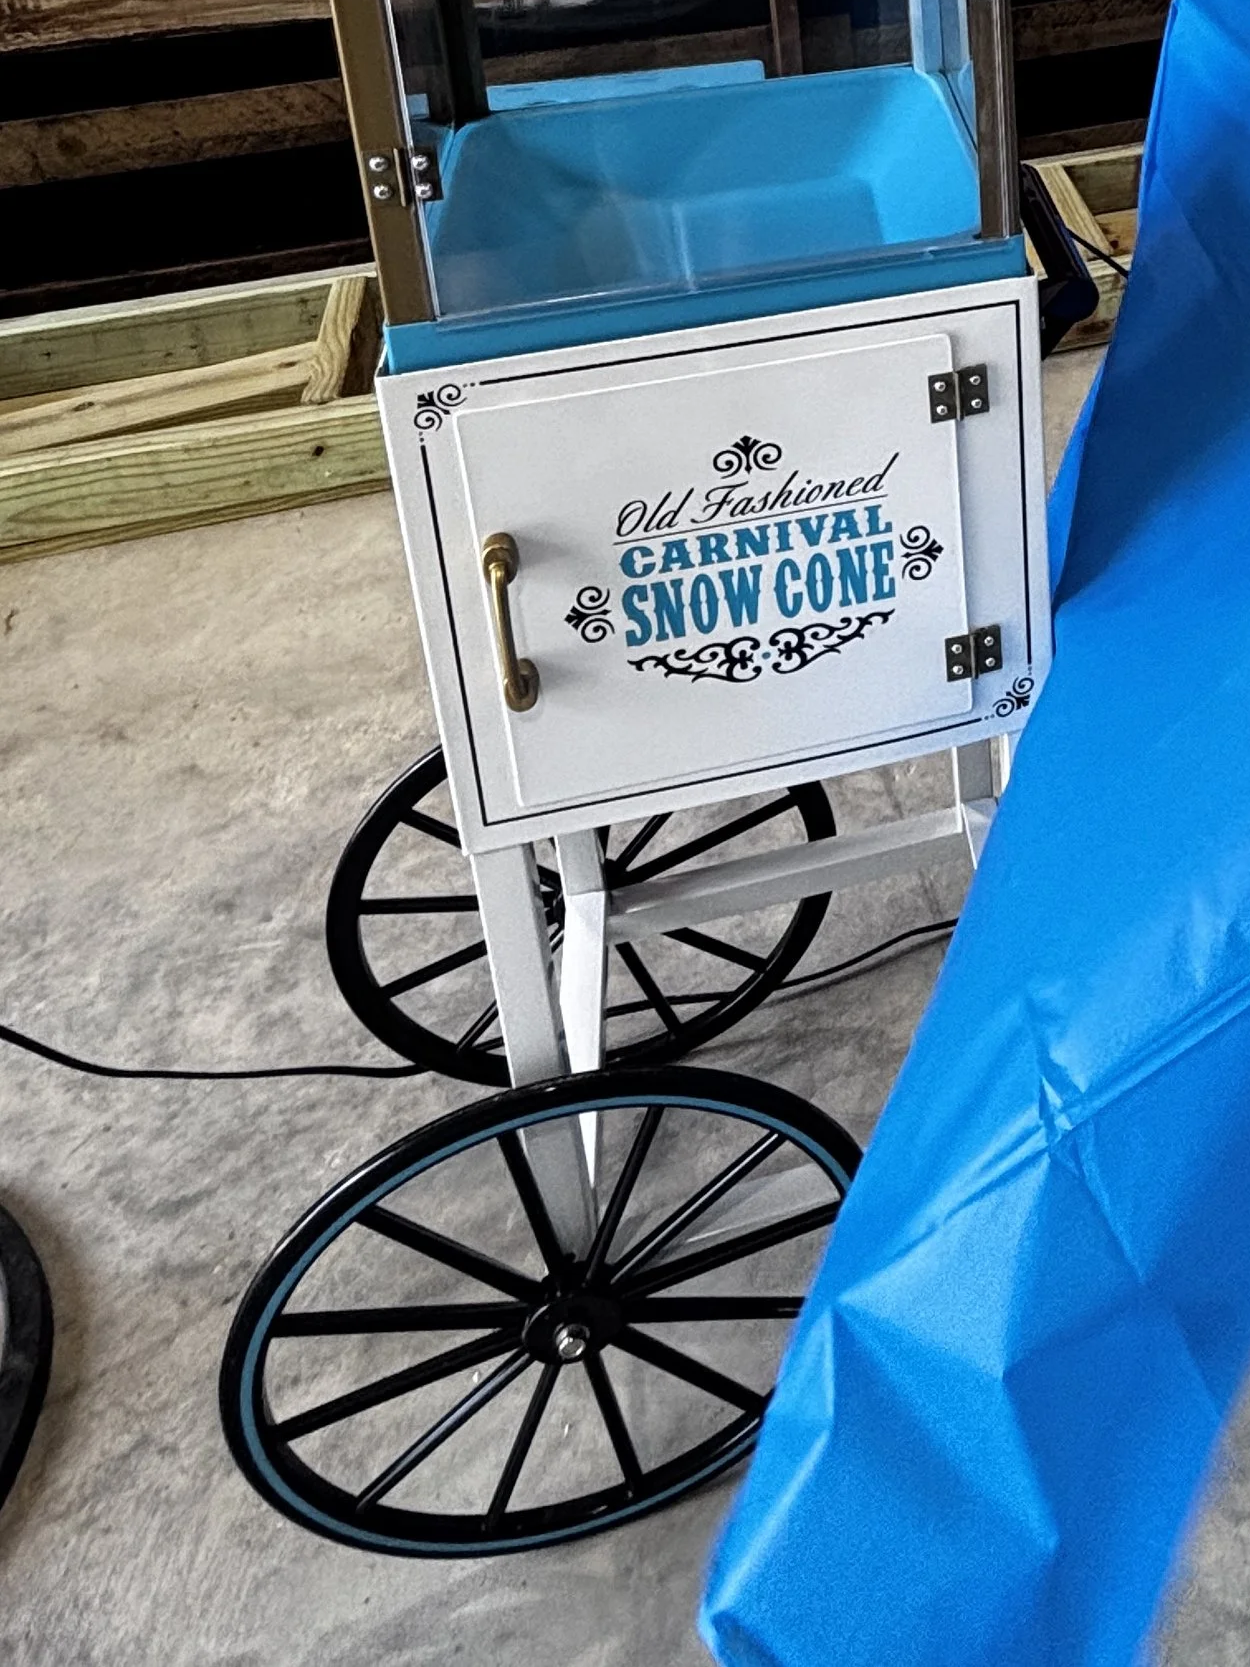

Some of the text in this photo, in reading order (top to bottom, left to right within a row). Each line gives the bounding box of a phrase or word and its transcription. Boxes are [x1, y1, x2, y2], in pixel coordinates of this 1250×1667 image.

[616, 451, 900, 537] Old Fashioned
[619, 504, 893, 578] CARNIVAL
[621, 540, 896, 647] SNOW CONE
